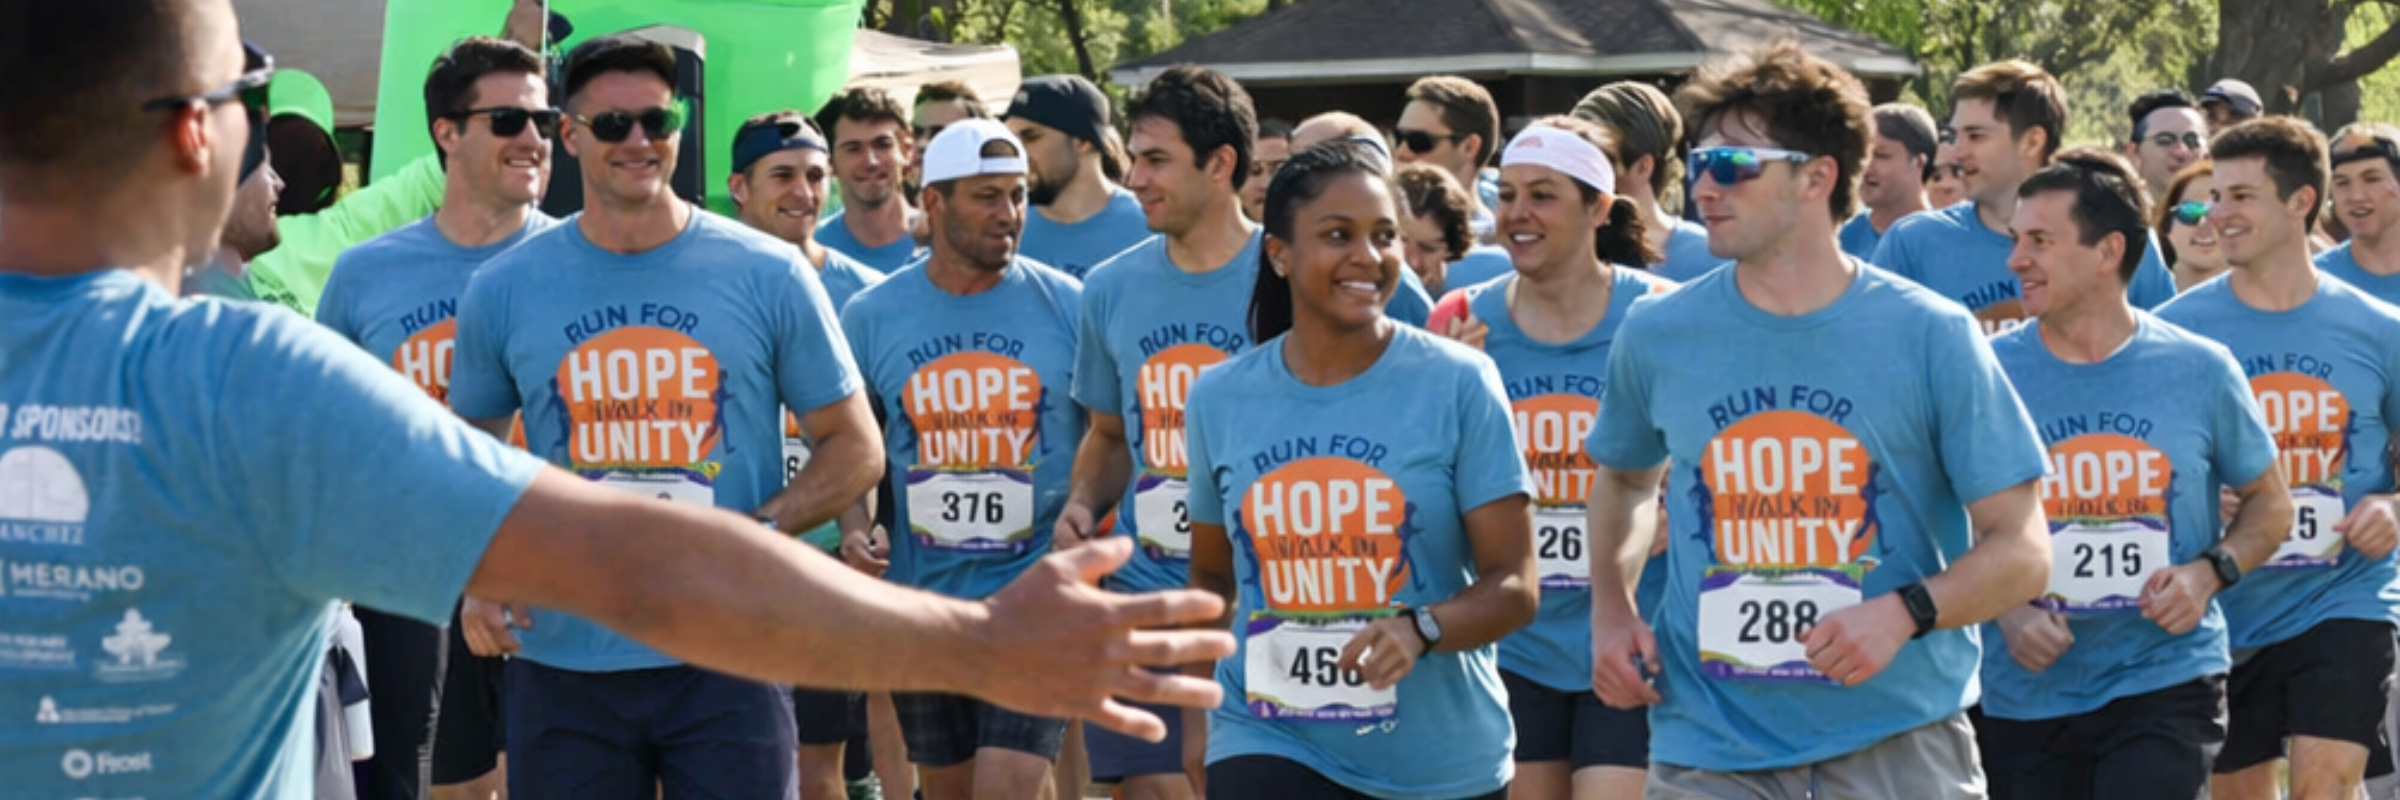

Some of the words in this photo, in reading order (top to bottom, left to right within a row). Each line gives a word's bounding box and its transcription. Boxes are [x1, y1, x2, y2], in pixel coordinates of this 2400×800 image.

[400, 298, 456, 335] RUN
[564, 303, 628, 345] RUN
[640, 302, 699, 336] FOR
[907, 333, 961, 369] RUN
[973, 332, 1024, 360] FOR
[1139, 323, 1187, 357] RUN
[1196, 323, 1244, 355] FOR
[569, 347, 710, 402] HOPE
[2284, 352, 2333, 380] FOR
[912, 367, 1032, 415] HOPE
[1708, 386, 1776, 430] RUN
[1791, 385, 1853, 424] FOR
[578, 420, 709, 463] UNITY
[922, 427, 1032, 465] UNITY
[2039, 414, 2088, 446] UN
[2098, 412, 2153, 441] FOR
[1253, 436, 1317, 473] RUN
[1329, 434, 1388, 467] FOR
[1711, 436, 1858, 494] HOPE
[2042, 450, 2162, 499] HOPE
[941, 491, 1004, 523] 376
[1253, 478, 1394, 537] HOPE
[1538, 526, 1582, 561] 26
[1722, 518, 1859, 565] UNITY
[2073, 543, 2142, 578] 215
[10, 562, 144, 592] MERANO
[1266, 557, 1394, 605] UNITY
[1738, 599, 1818, 644] 288
